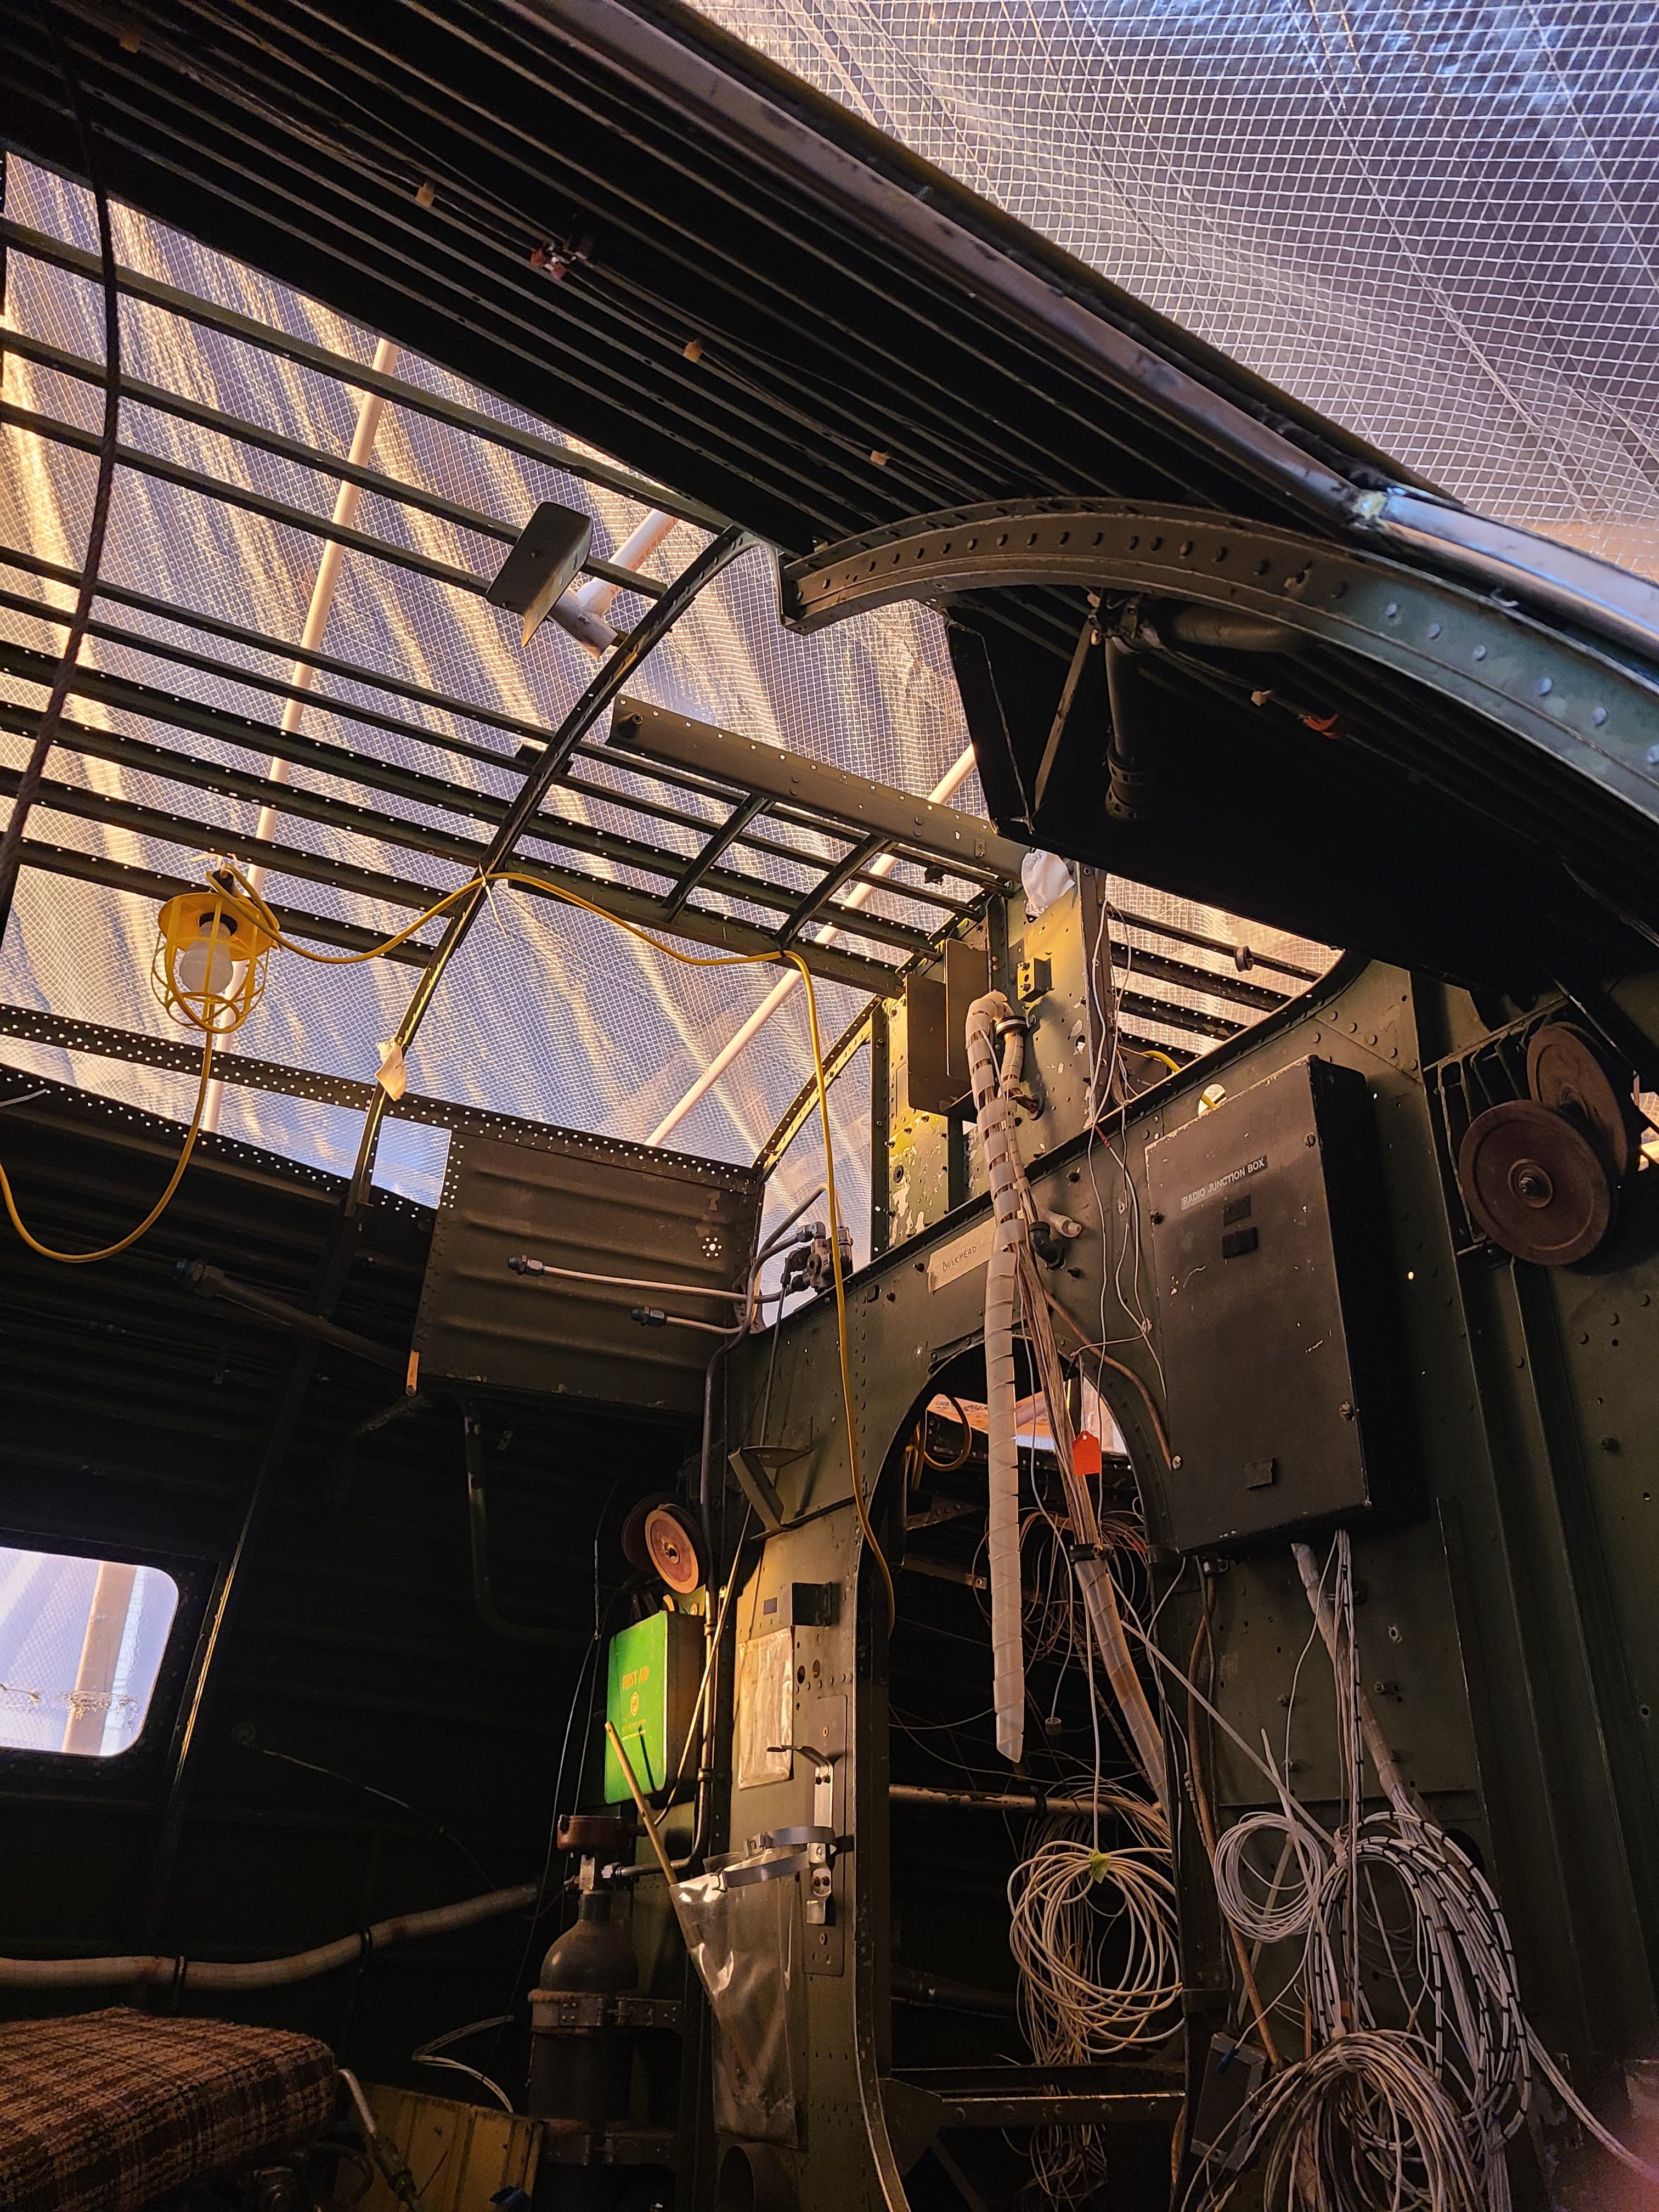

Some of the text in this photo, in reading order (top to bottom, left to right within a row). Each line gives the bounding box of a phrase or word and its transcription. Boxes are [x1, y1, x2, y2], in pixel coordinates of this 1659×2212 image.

[1182, 1158, 1265, 1205] RADIO JUNCTION BOX
[943, 1246, 977, 1272] BULKHEAD
[639, 1666, 649, 1683] AID
